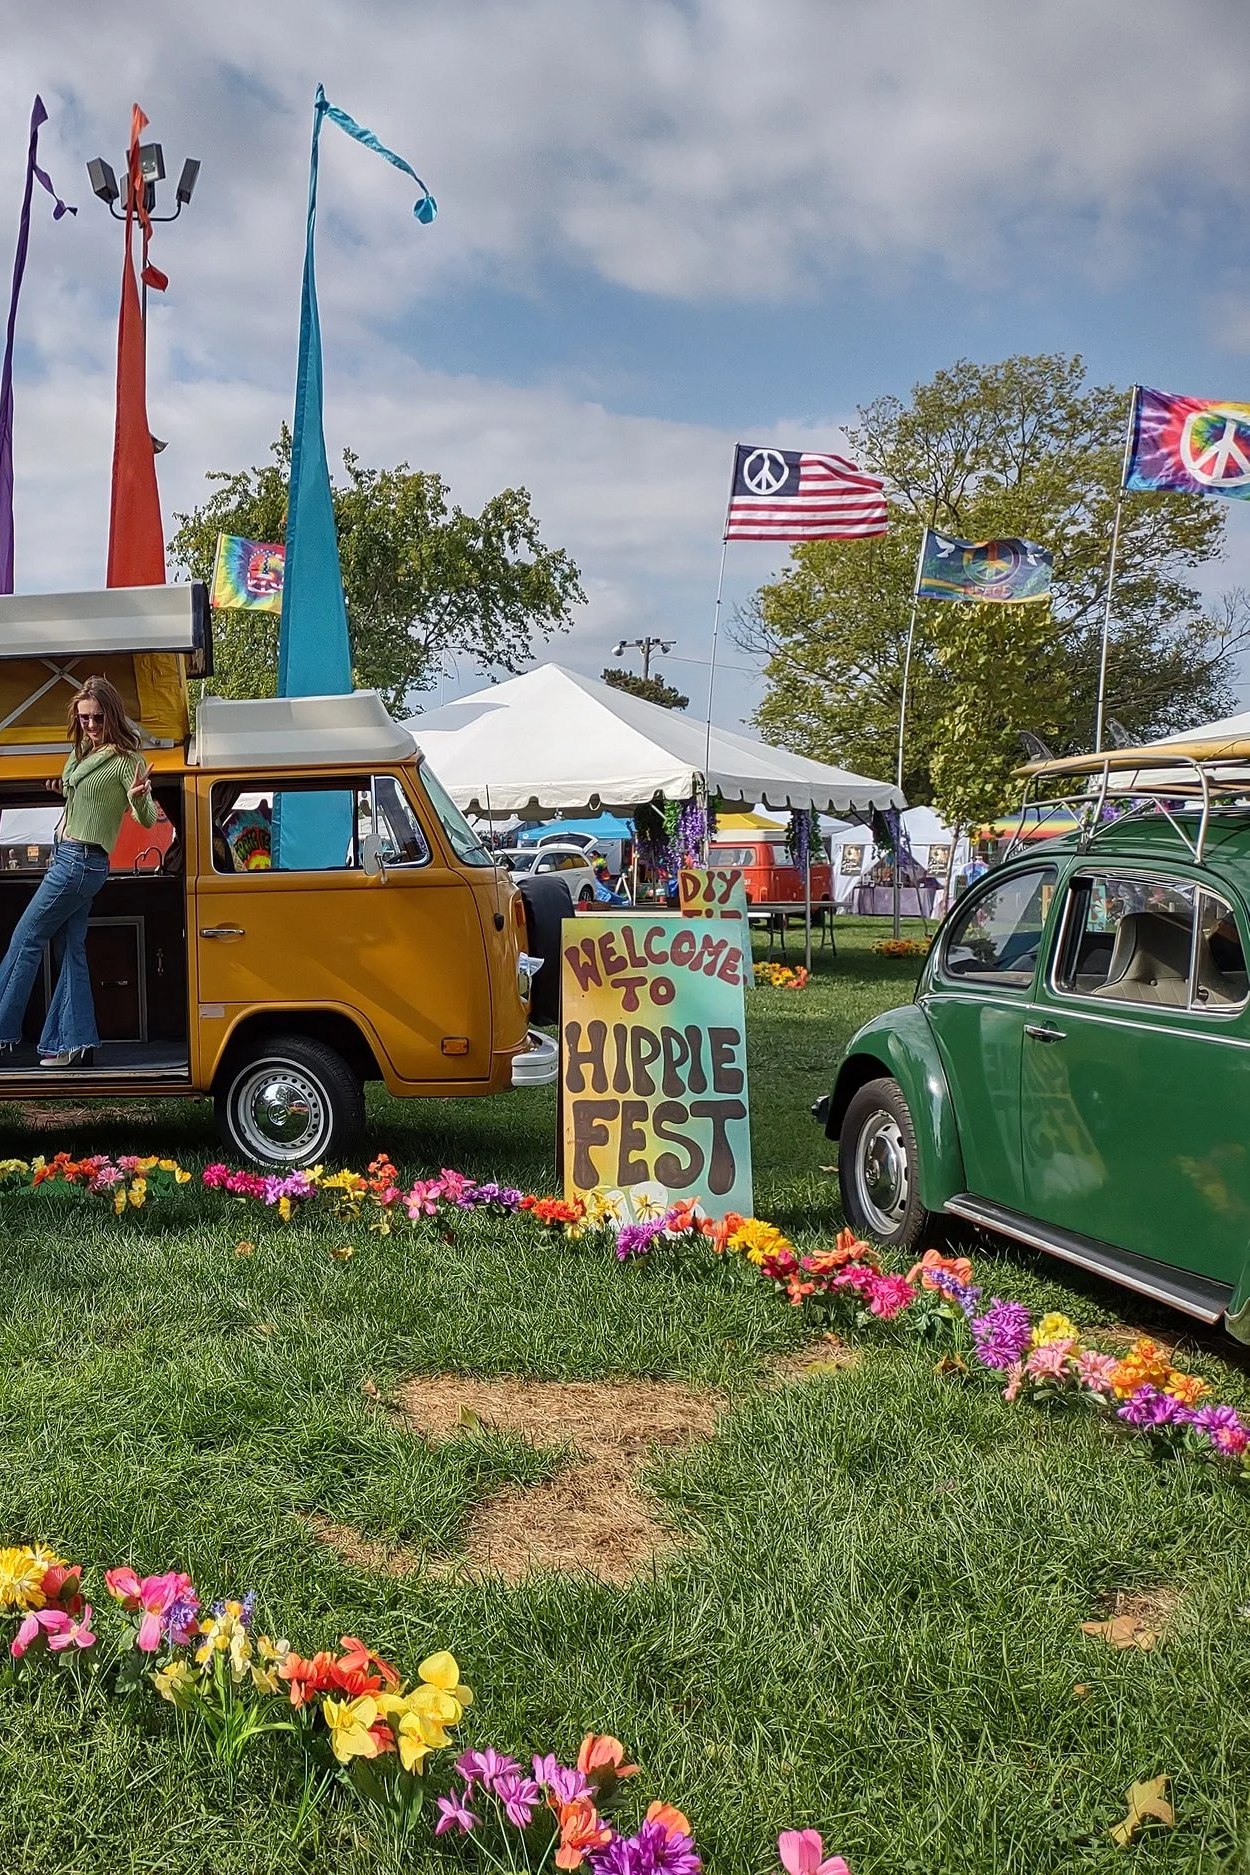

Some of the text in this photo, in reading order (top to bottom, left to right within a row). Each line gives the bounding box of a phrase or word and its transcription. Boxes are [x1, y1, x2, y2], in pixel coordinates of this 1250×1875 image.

[680, 869, 742, 905] DIY
[564, 925, 742, 991] WELCOME
[611, 975, 675, 1012] TO
[565, 1020, 744, 1097] HIPPIE
[572, 1099, 747, 1195] FEST
